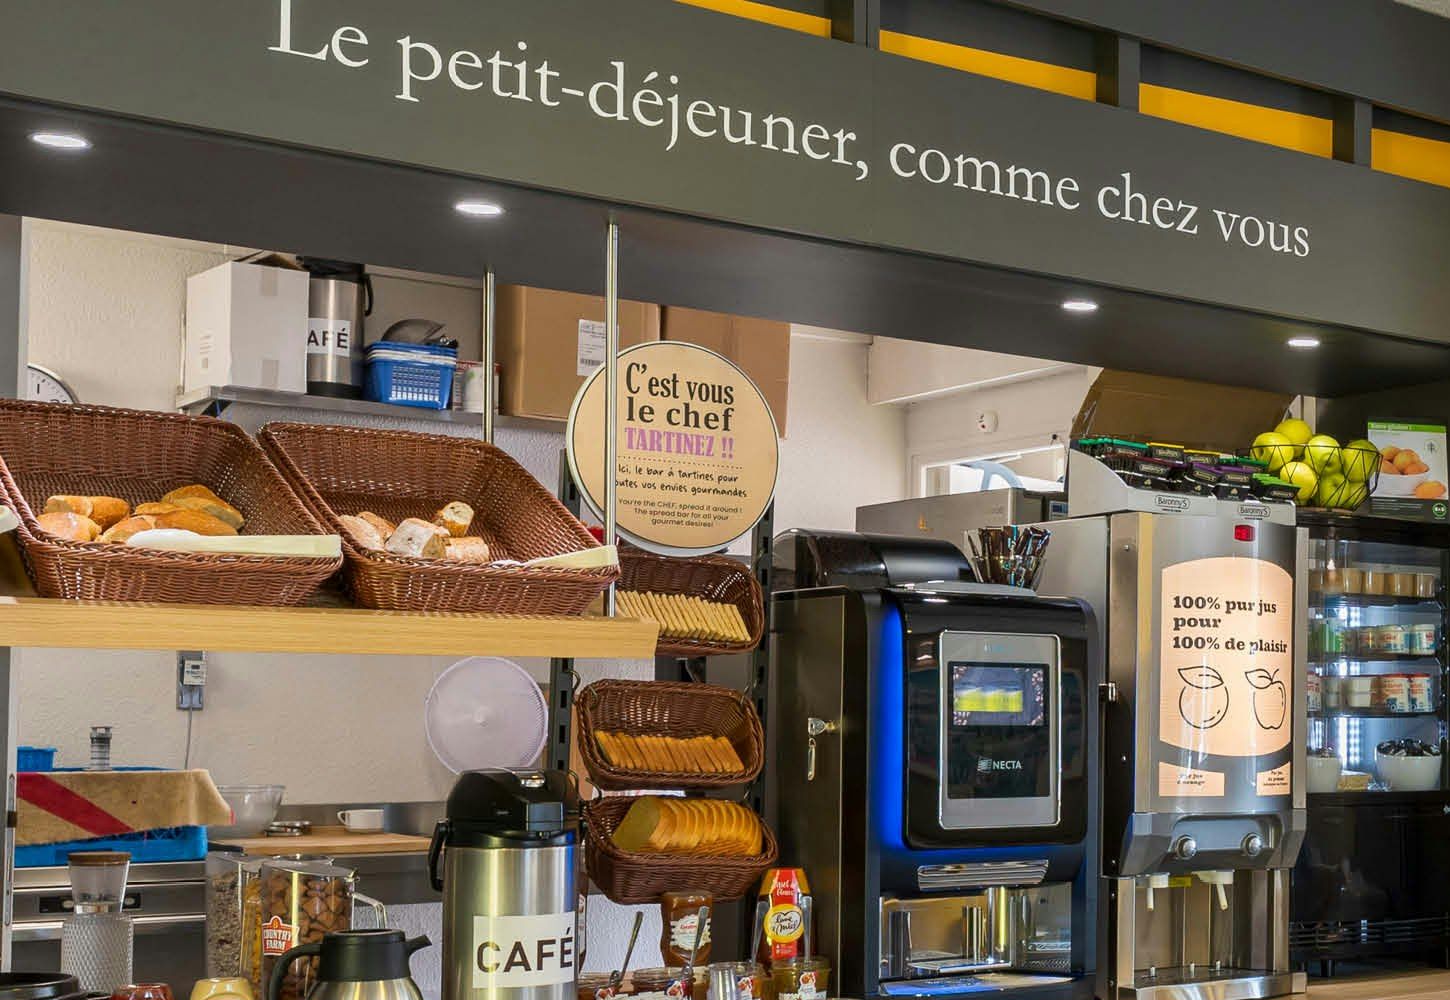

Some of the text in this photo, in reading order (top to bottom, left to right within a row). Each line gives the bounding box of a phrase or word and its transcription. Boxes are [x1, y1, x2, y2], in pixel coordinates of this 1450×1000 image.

[268, 0, 1310, 258] Le petit-déjeuner, comme chez vous
[307, 328, 349, 349] AFÉ
[626, 362, 734, 406] C'est vous
[626, 396, 735, 432] le chef
[624, 427, 734, 460] TARTINEZ !!
[635, 464, 643, 475] le
[647, 466, 664, 476] bar
[678, 469, 714, 481] tartines
[717, 474, 739, 484] pour
[615, 479, 748, 498] outes vos envies gourmandes
[1173, 595, 1277, 616] 100% pur jus
[1173, 617, 1221, 631] pour
[1173, 636, 1288, 655] 100% de plaisir
[992, 760, 1022, 770] NECTA
[477, 926, 574, 973] CAFÉ
